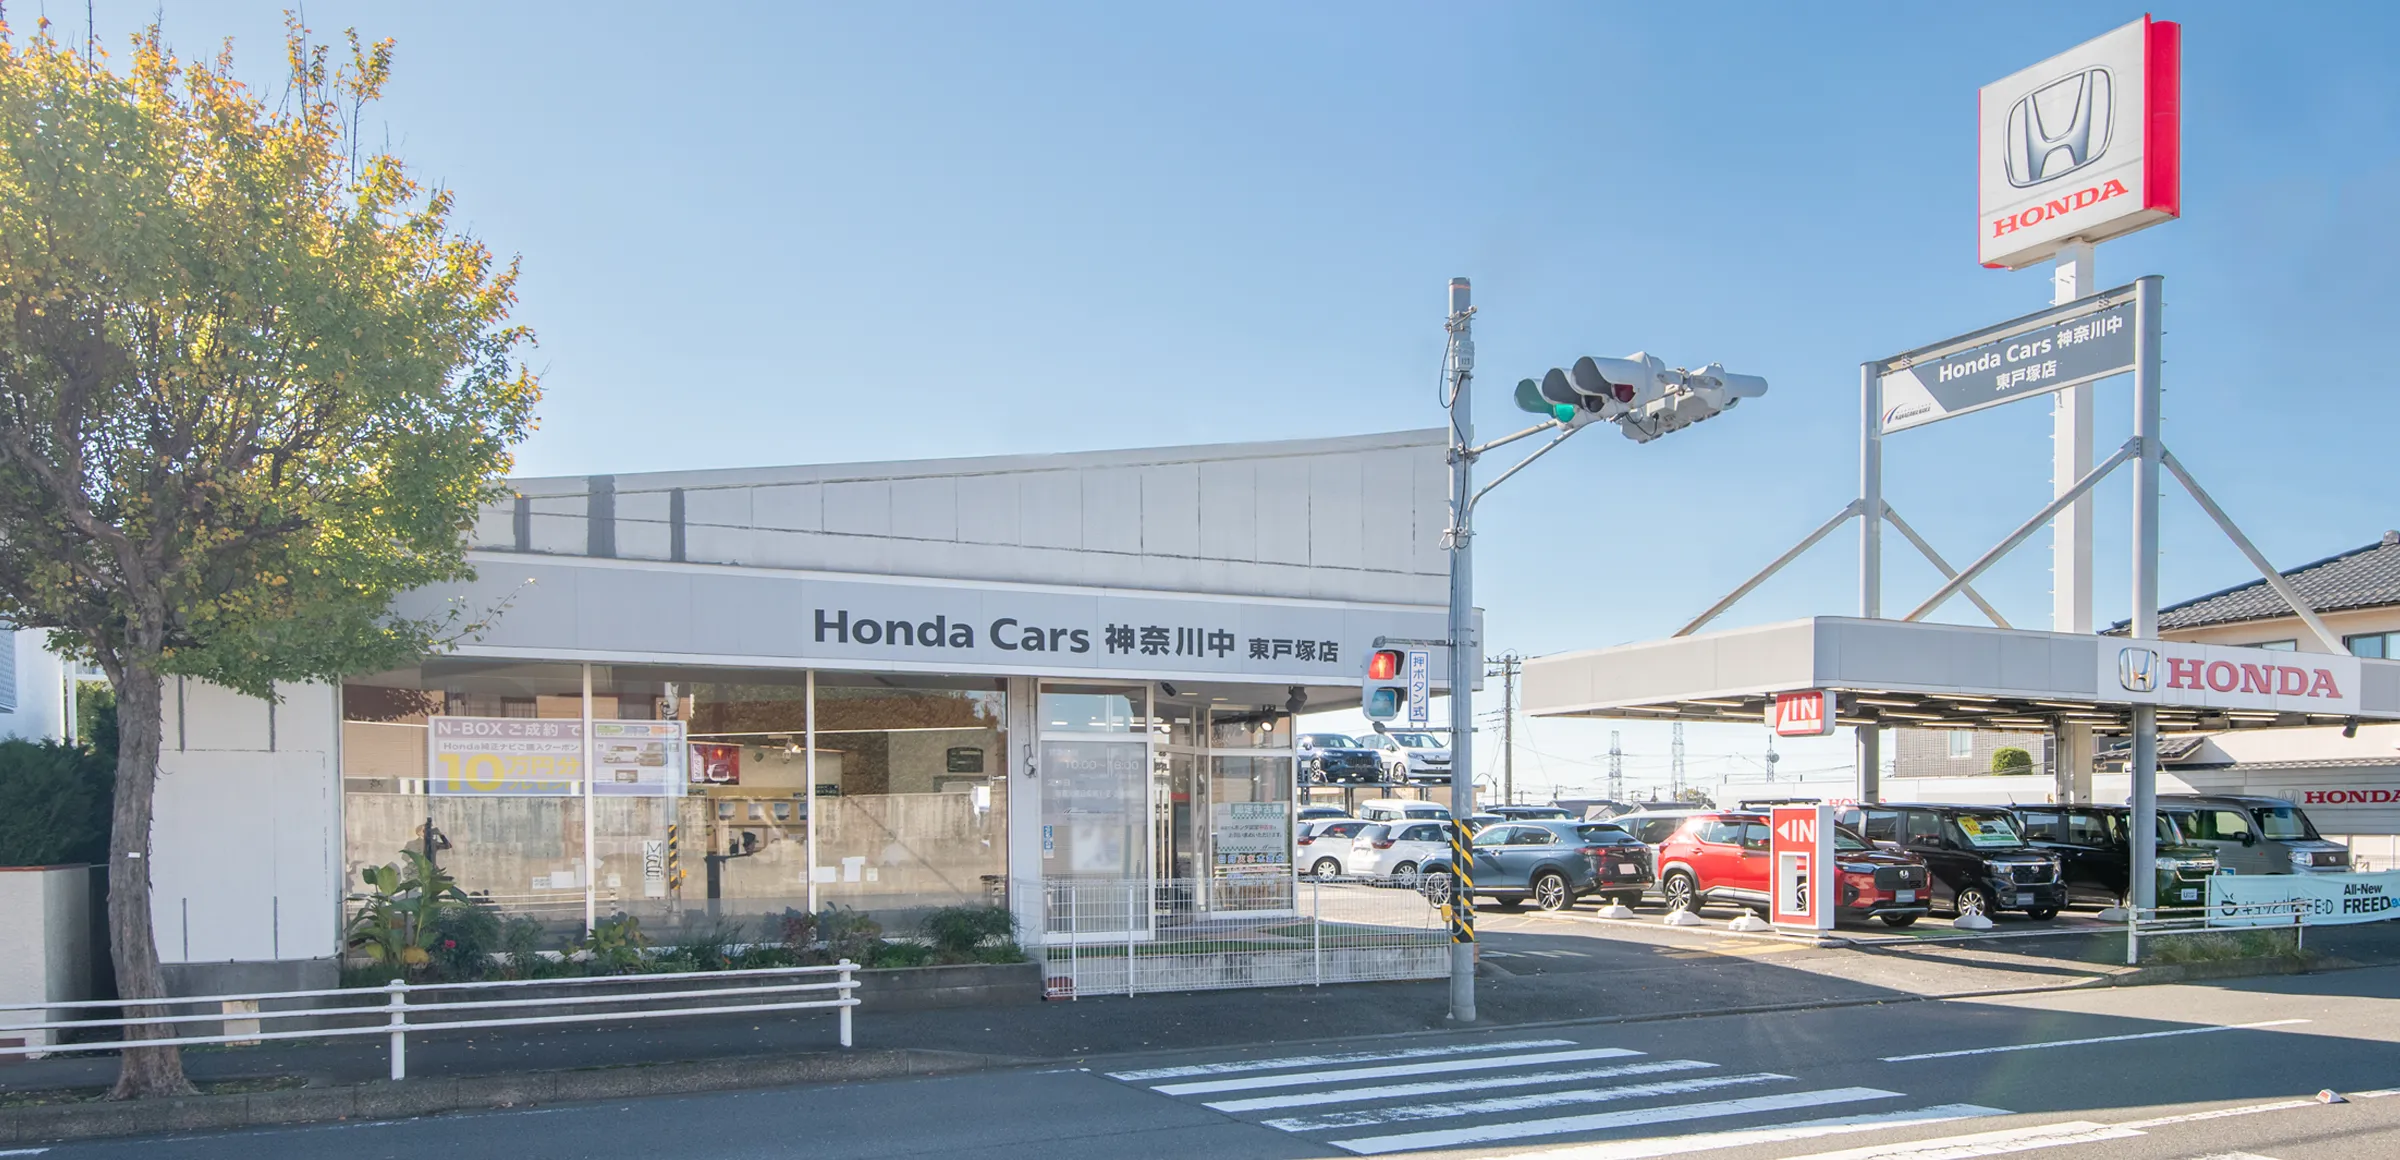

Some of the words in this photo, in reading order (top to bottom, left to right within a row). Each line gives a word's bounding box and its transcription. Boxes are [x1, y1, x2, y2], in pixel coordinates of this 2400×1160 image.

[1993, 178, 2129, 238] HONDA
[1939, 353, 2001, 383] Honda
[2006, 339, 2052, 363] Cars
[2057, 315, 2123, 349] 神奈川中
[1996, 360, 2057, 391] 東戸塚店
[814, 609, 975, 648] Honda
[990, 618, 1091, 653] Cars
[1105, 623, 1235, 658] 神奈川中
[1248, 637, 1339, 662] 東戸塚店
[1413, 656, 1425, 717] 押ボタン式
[2166, 657, 2343, 699] HONDA
[1791, 696, 1817, 720] IN
[438, 722, 503, 736] N-BOX
[1792, 819, 1815, 843] IN
[2343, 883, 2383, 896] All-New
[2343, 895, 2392, 914] FREED
